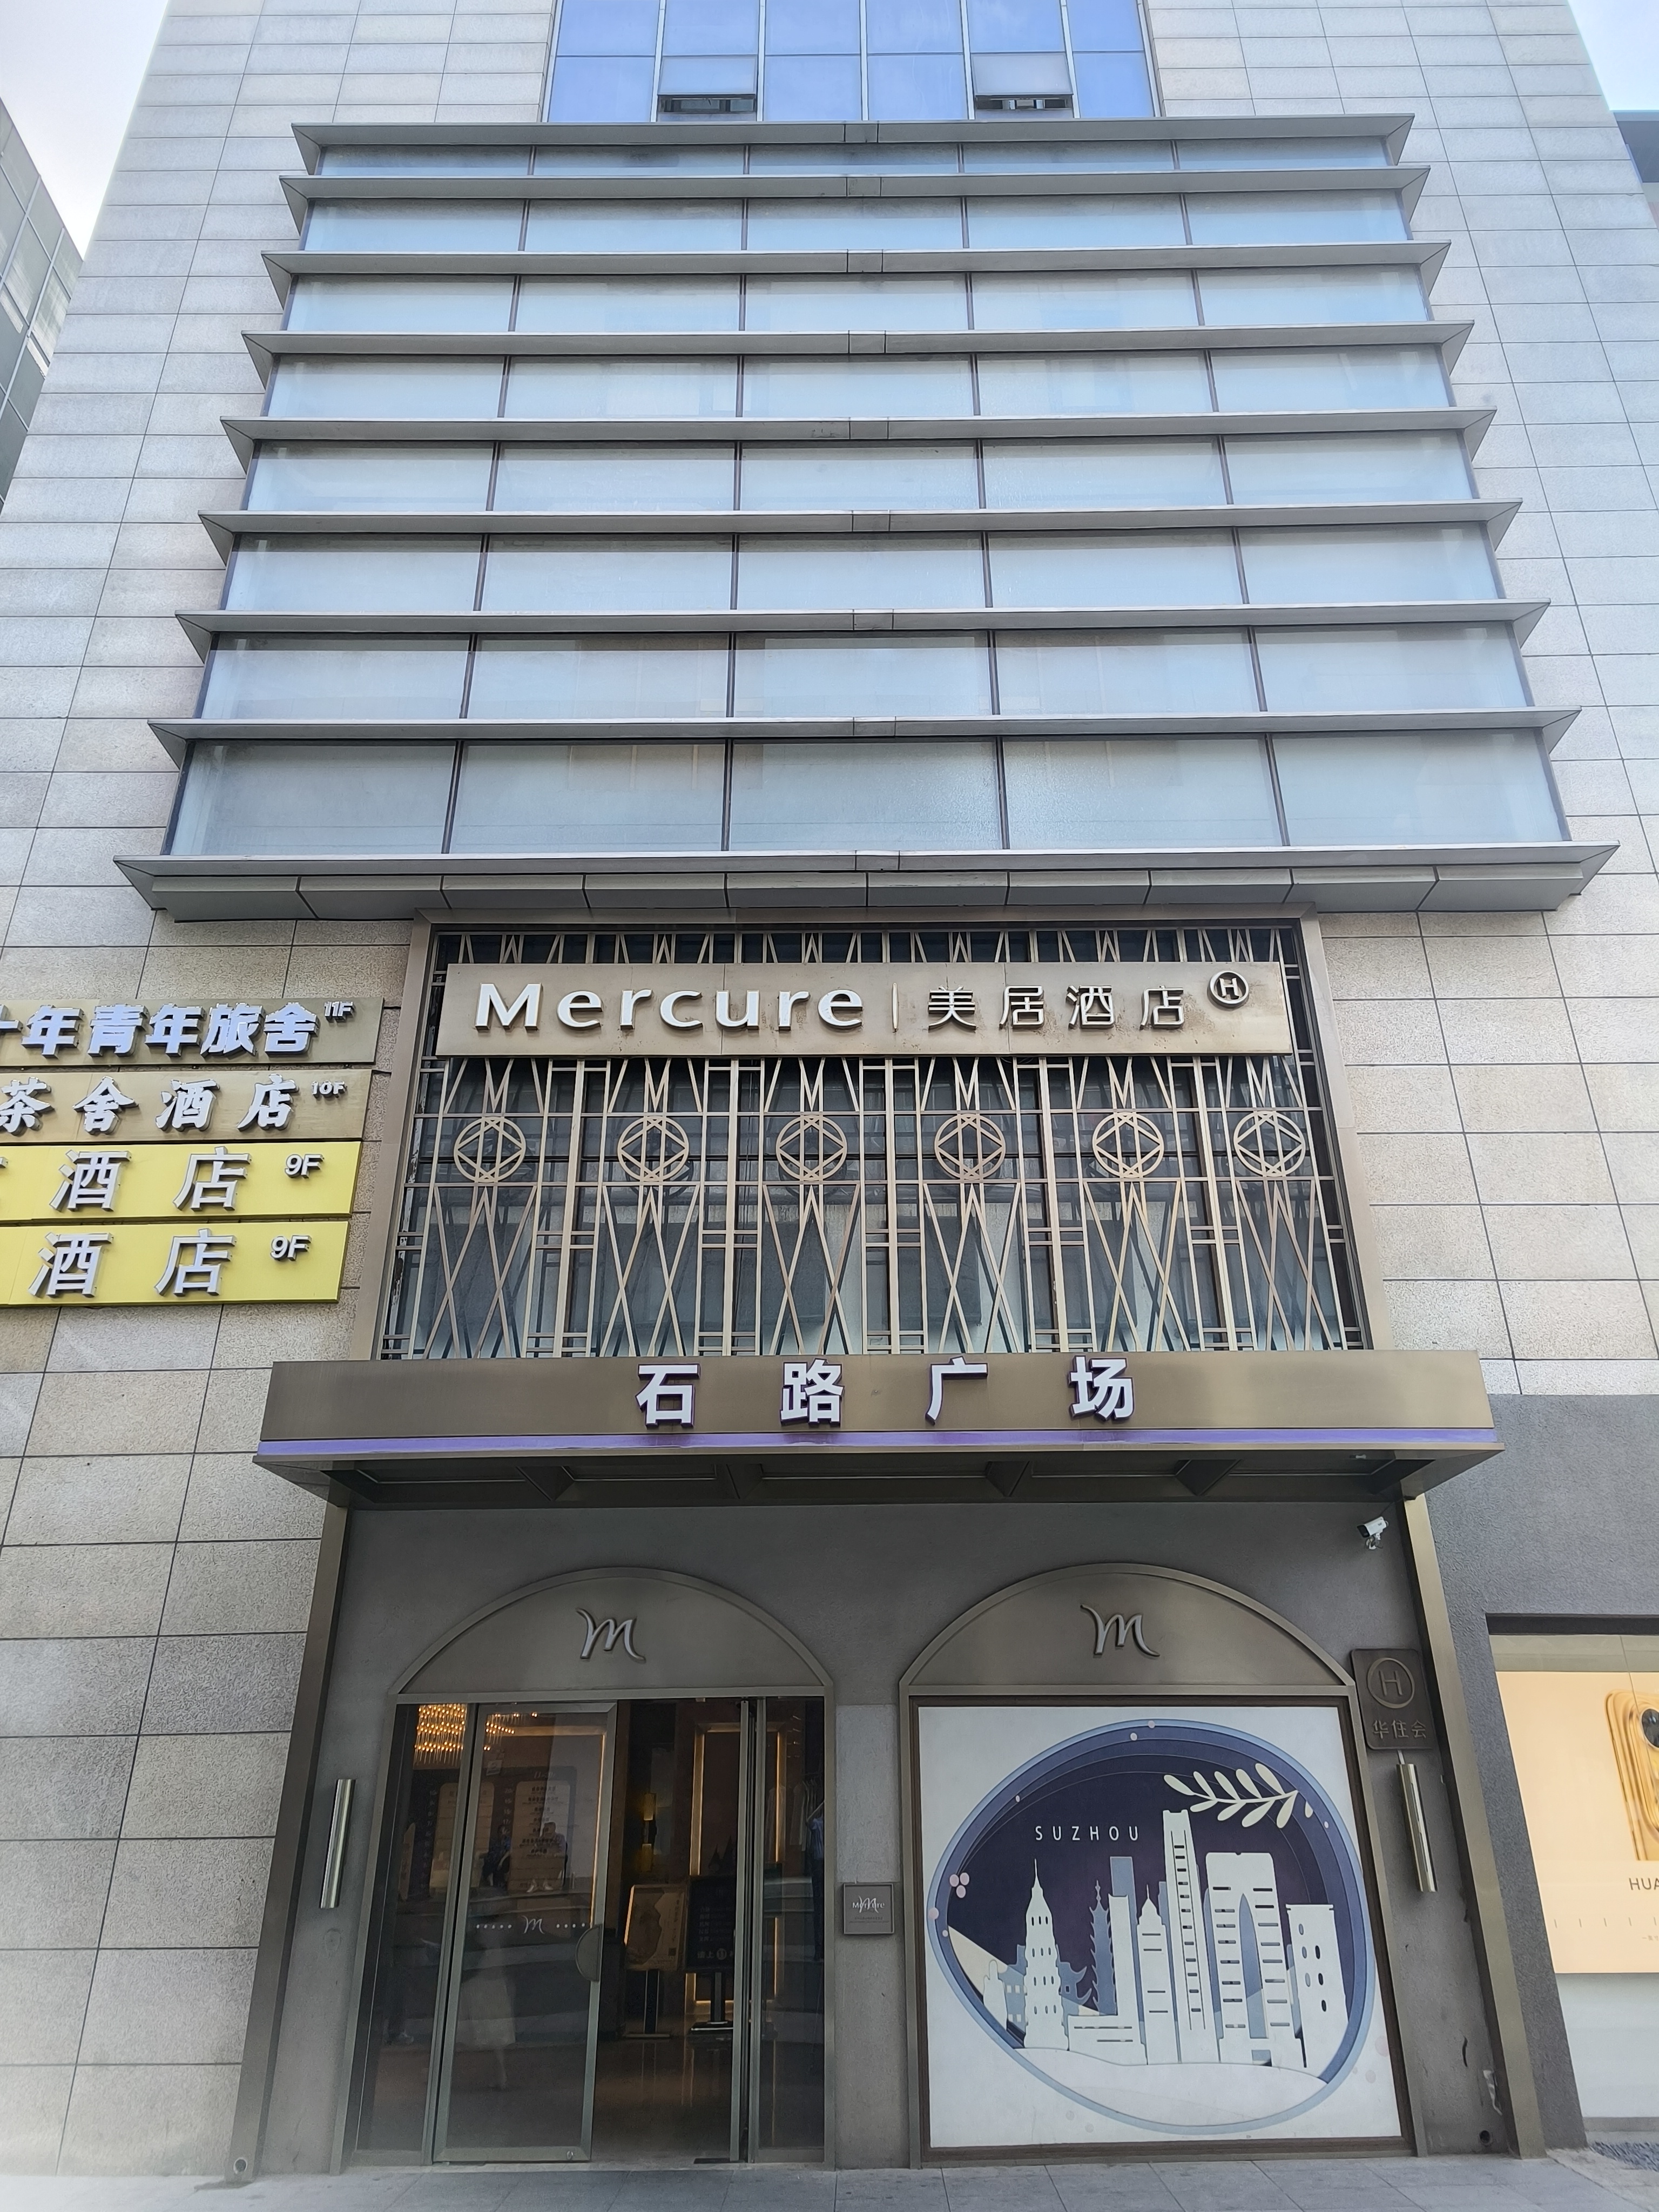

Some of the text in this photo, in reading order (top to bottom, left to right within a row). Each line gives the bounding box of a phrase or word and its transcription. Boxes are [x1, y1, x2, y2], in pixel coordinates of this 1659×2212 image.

[324, 1001, 354, 1021] 11F
[475, 982, 864, 1030] Mercure
[927, 984, 1185, 1031] 美居酒店
[0, 1073, 348, 1134] 茶舍酒店 10F
[0, 1145, 325, 1212] 酒店 9F
[28, 1228, 312, 1297] 酒店 9F
[634, 1355, 1136, 1427] 石路广场
[1372, 1719, 1427, 1739] 华住会
[1035, 1825, 1140, 1842] SUZHOU
